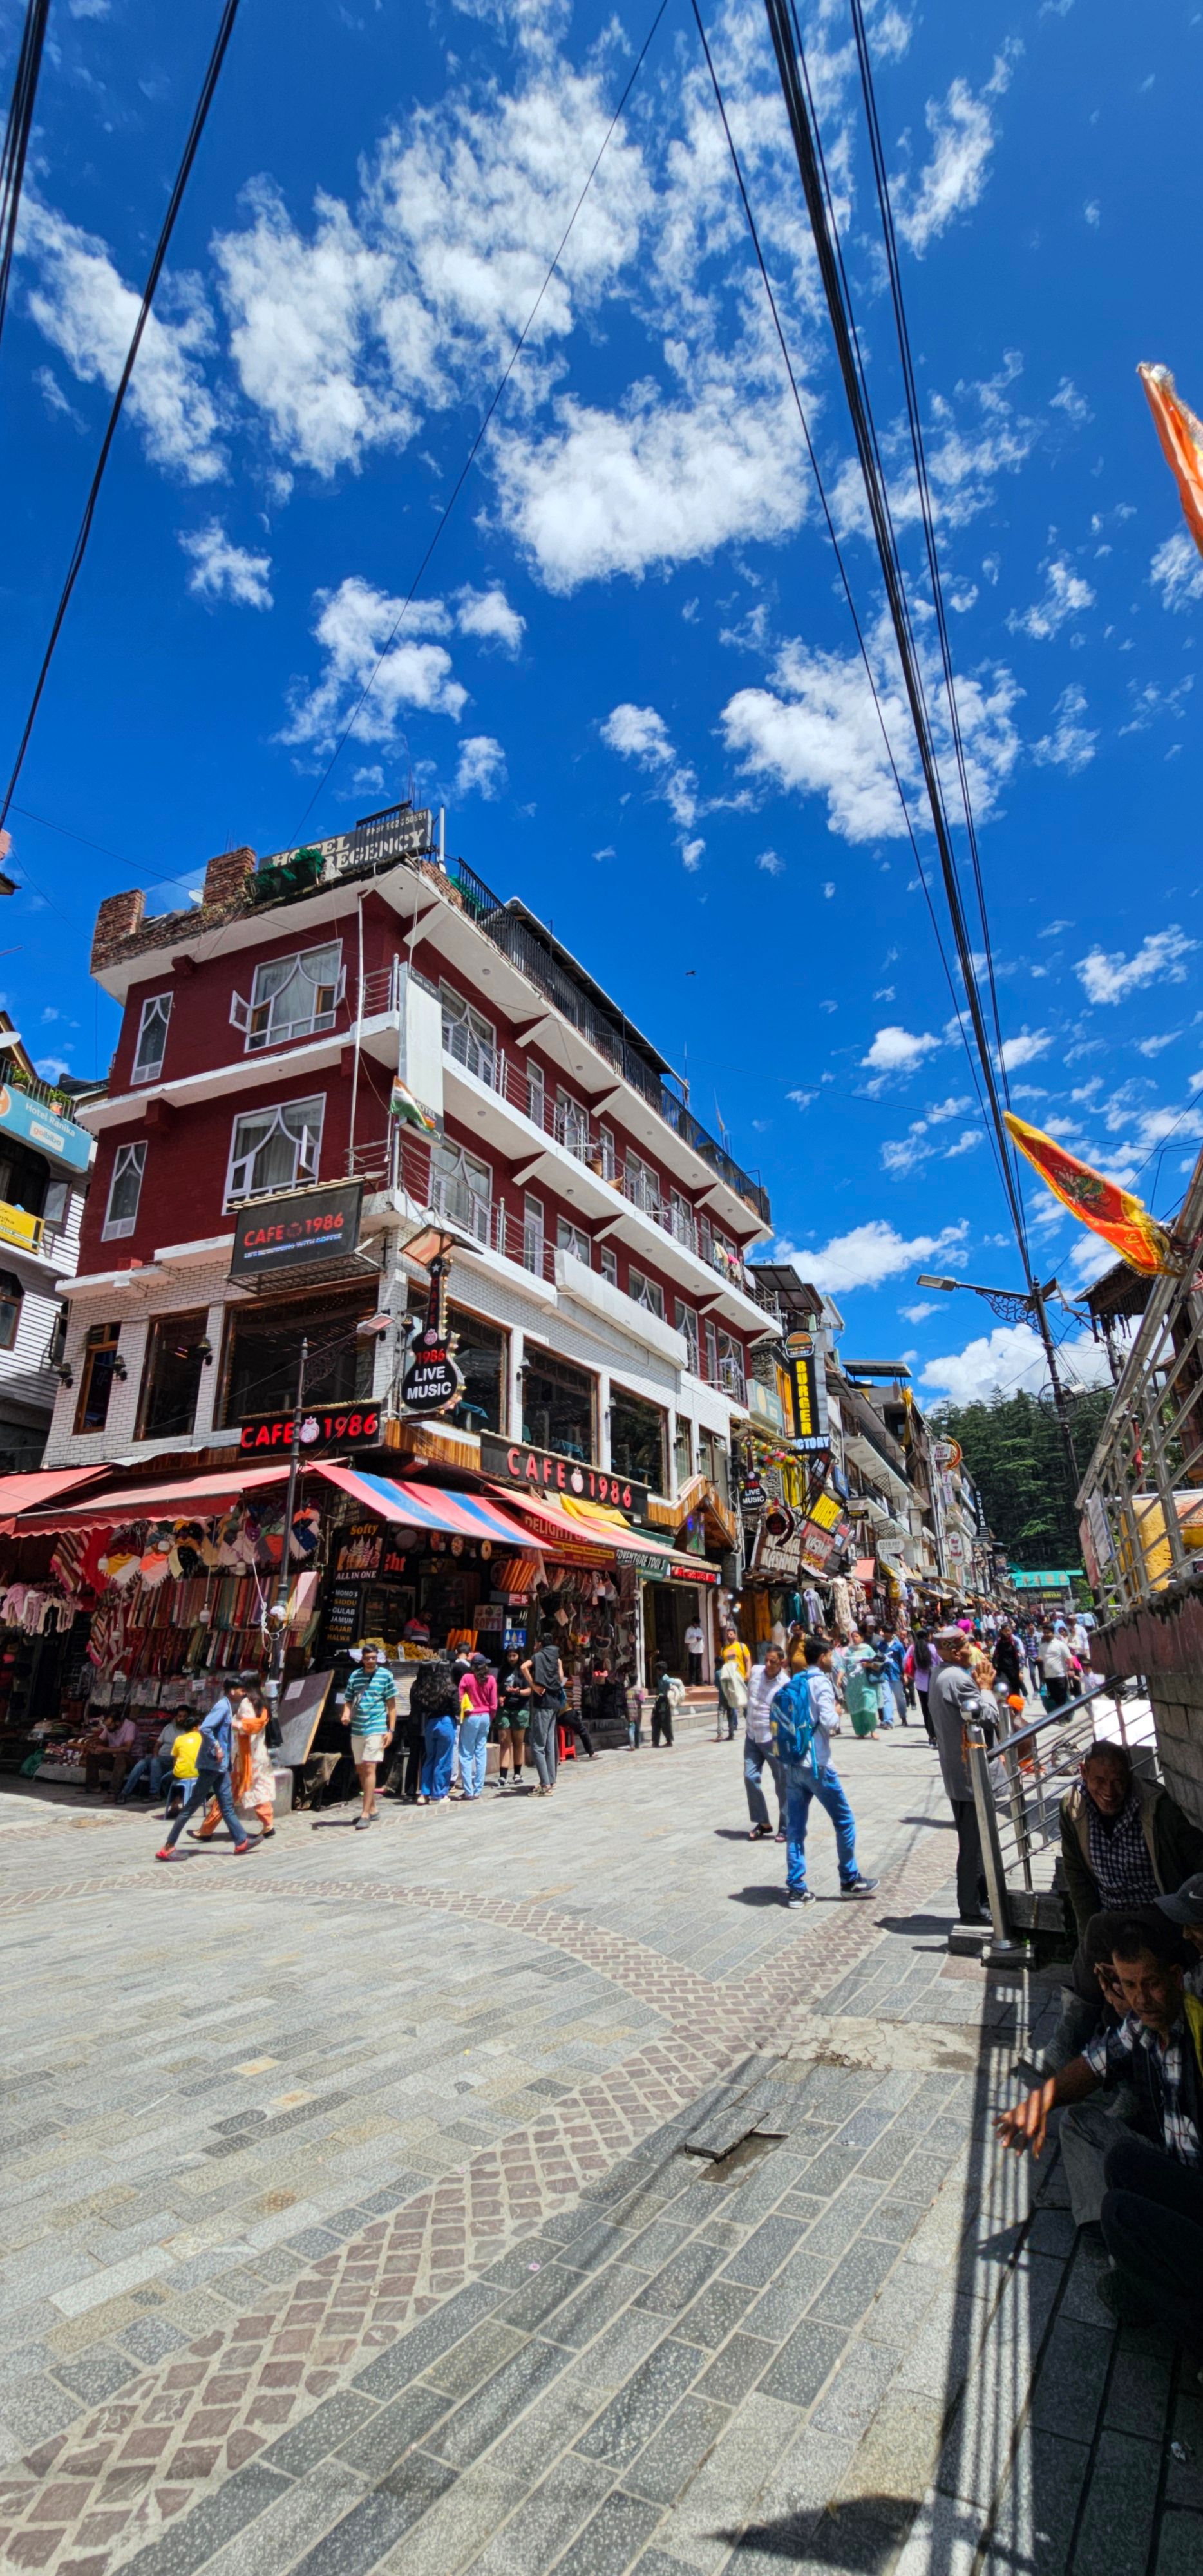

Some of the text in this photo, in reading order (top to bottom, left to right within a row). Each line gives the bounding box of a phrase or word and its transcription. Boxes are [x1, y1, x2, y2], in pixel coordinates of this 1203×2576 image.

[26, 1103, 75, 1137] Hotel Ranika
[33, 1128, 61, 1146] goibibo
[243, 1211, 345, 1247] CAFE 1986
[430, 1278, 439, 1325] CAFE
[417, 1349, 446, 1365] 1986
[415, 1365, 446, 1383] LIVE
[406, 1382, 451, 1400] MUSIC
[795, 1360, 812, 1435] BURGER
[241, 1412, 379, 1448] CAFE 1986
[790, 1436, 829, 1450] ACTORY
[507, 1447, 632, 1508] CAFE 1986
[742, 1495, 765, 1504] MUSIC
[744, 1488, 761, 1497] LIVE
[350, 1523, 379, 1536] Softy
[336, 1572, 351, 1580] ALL
[351, 1571, 360, 1580] IN
[332, 1607, 355, 1615] GULAB
[329, 1624, 352, 1633] GAJAR
[330, 1616, 354, 1625] JAMUN
